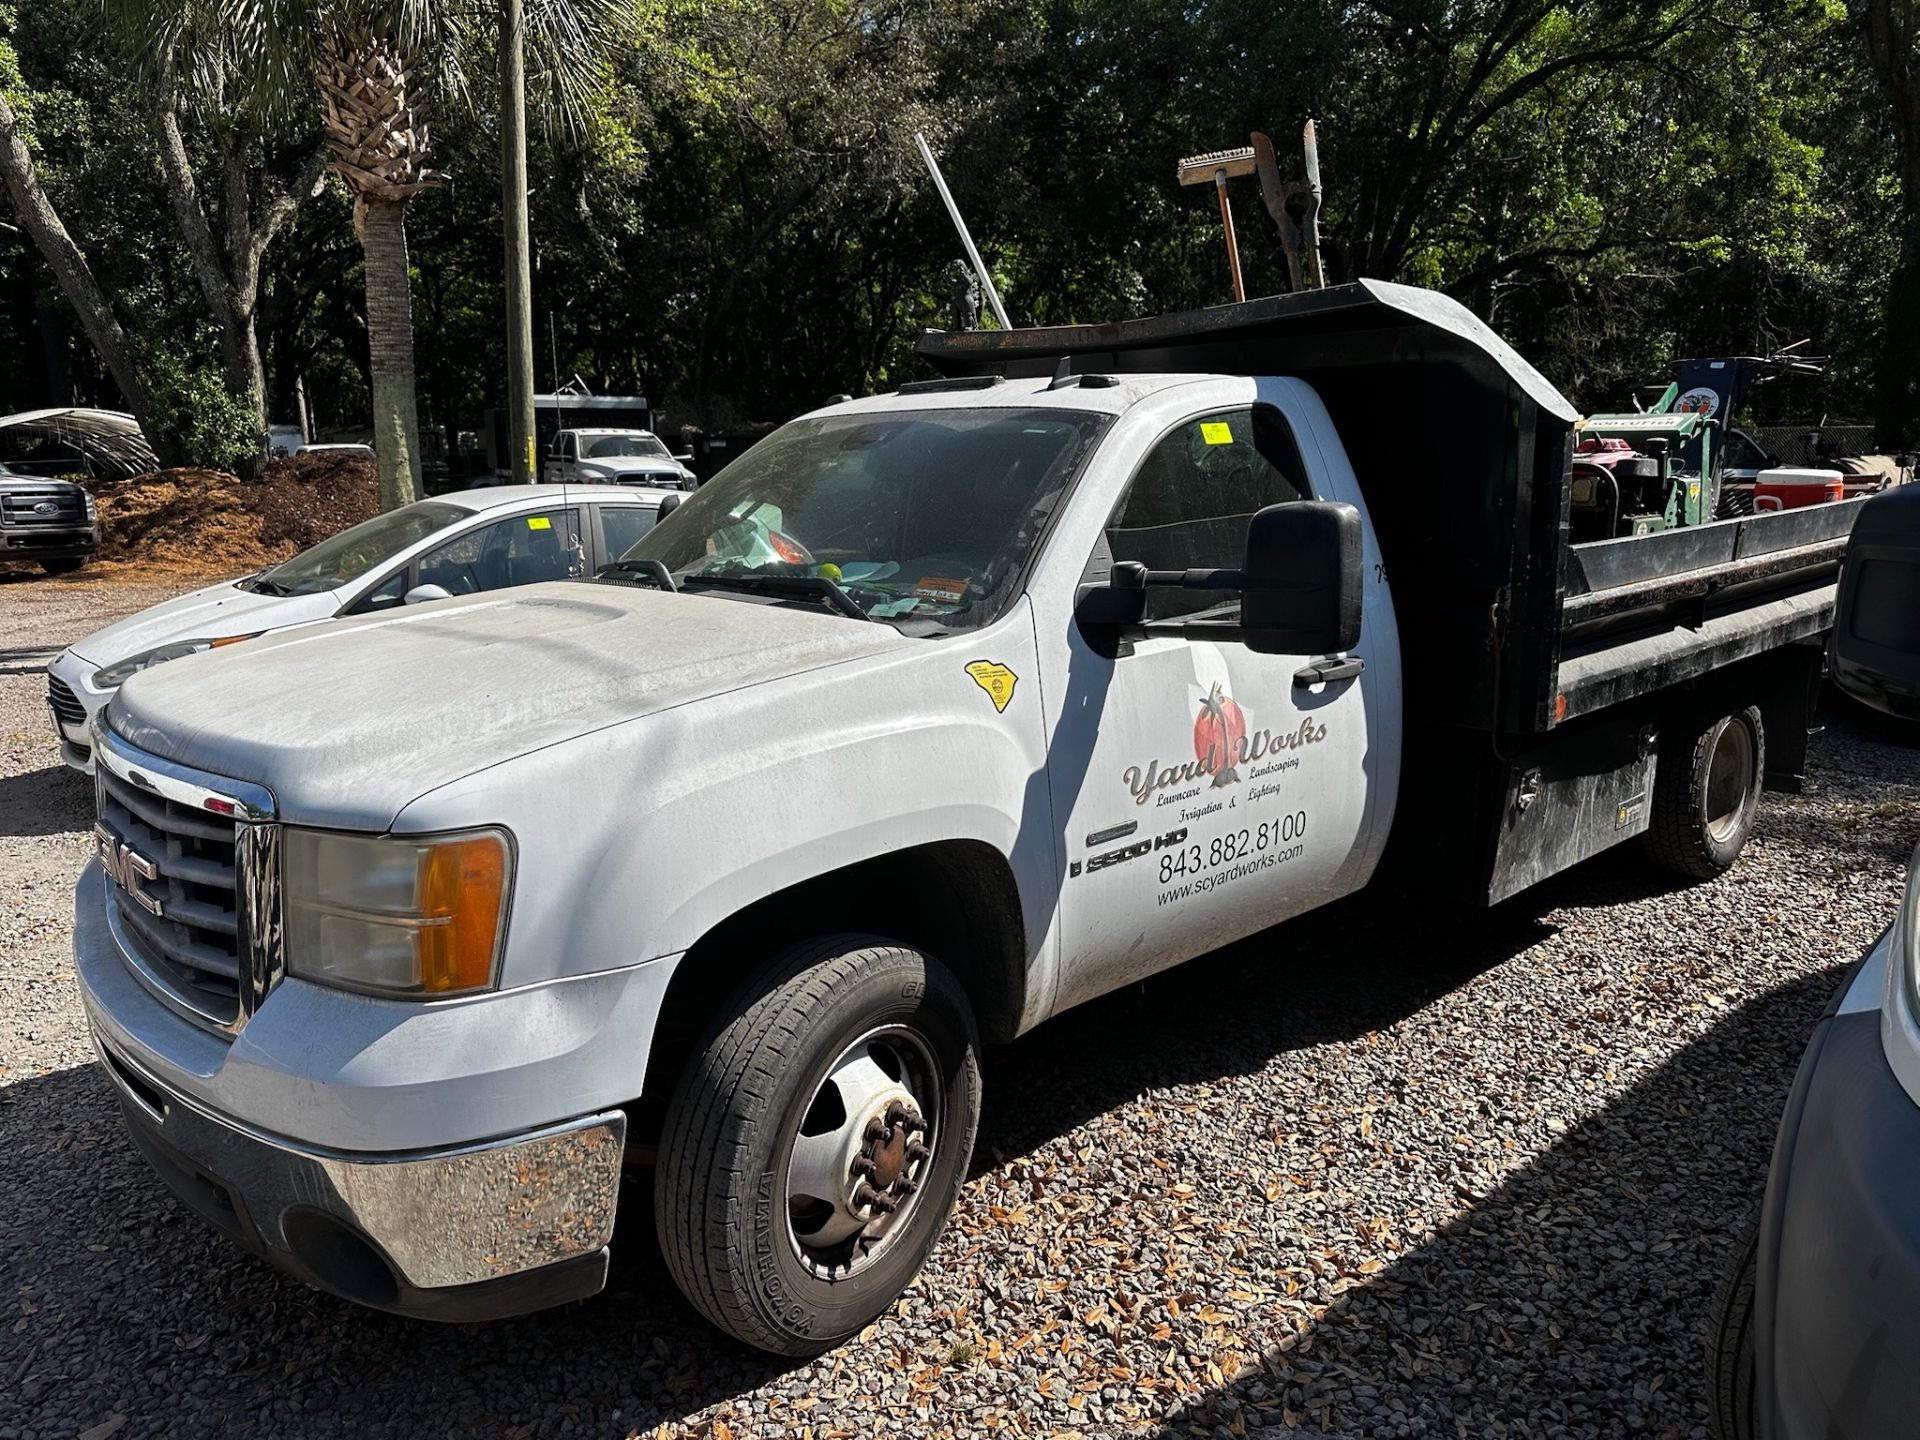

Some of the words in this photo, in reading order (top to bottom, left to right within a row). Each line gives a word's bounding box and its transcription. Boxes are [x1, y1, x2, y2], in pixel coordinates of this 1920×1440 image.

[1123, 743, 1217, 806] Yard
[1234, 716, 1327, 764] Works
[1156, 787, 1201, 807] Lawncare
[1249, 757, 1299, 779] Landscaping
[1178, 801, 1223, 822] Irrigation
[1229, 796, 1236, 808] &
[1247, 784, 1281, 801] Lighting
[1157, 844, 1303, 906] www.scyardworks.com
[1159, 810, 1306, 884] 843.882.8100
[754, 1171, 816, 1335] YOKOHAMA
